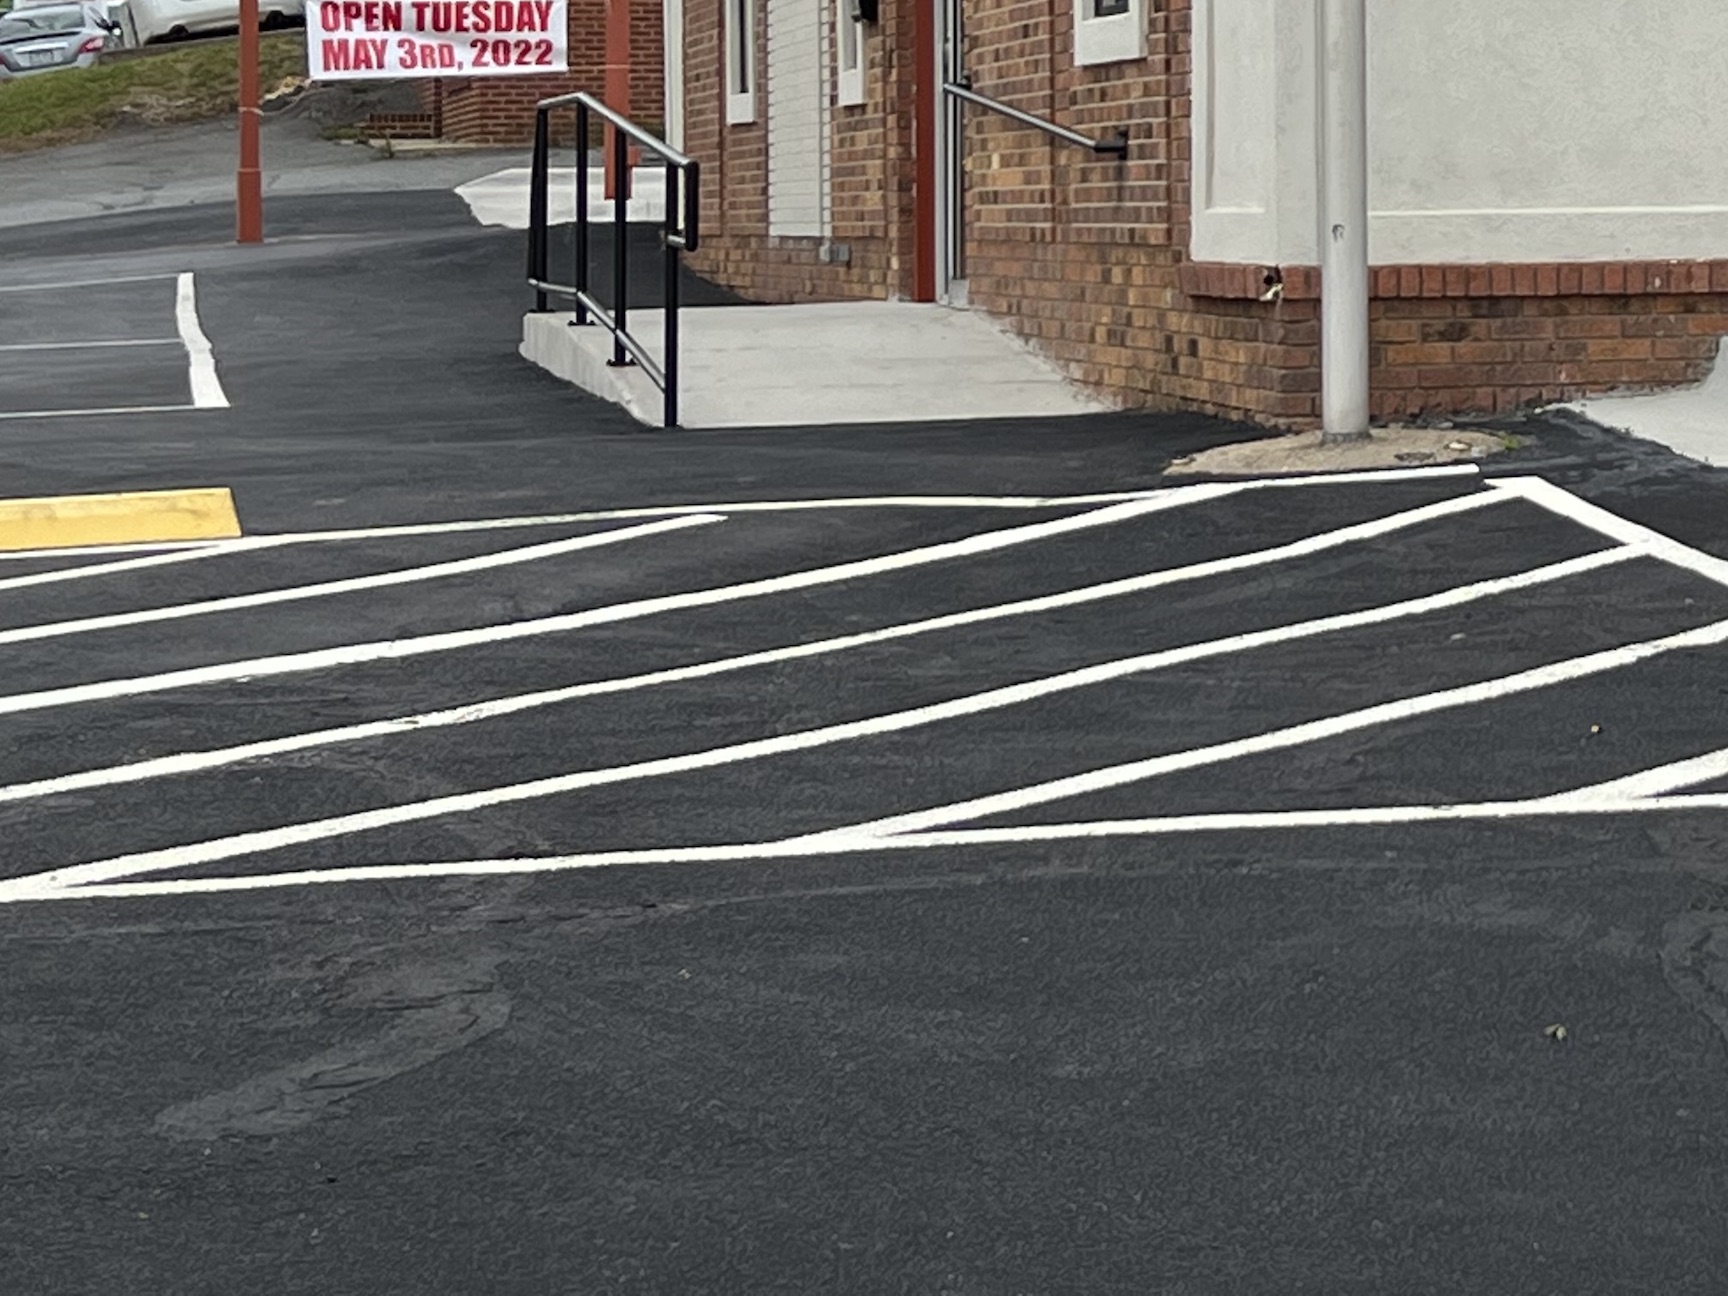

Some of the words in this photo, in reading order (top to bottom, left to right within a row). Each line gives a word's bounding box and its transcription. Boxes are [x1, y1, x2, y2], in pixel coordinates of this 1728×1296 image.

[320, 0, 403, 33] OPEN
[410, 0, 555, 34] TUESDAY
[321, 39, 388, 72] MAY
[470, 38, 553, 68] 2022
